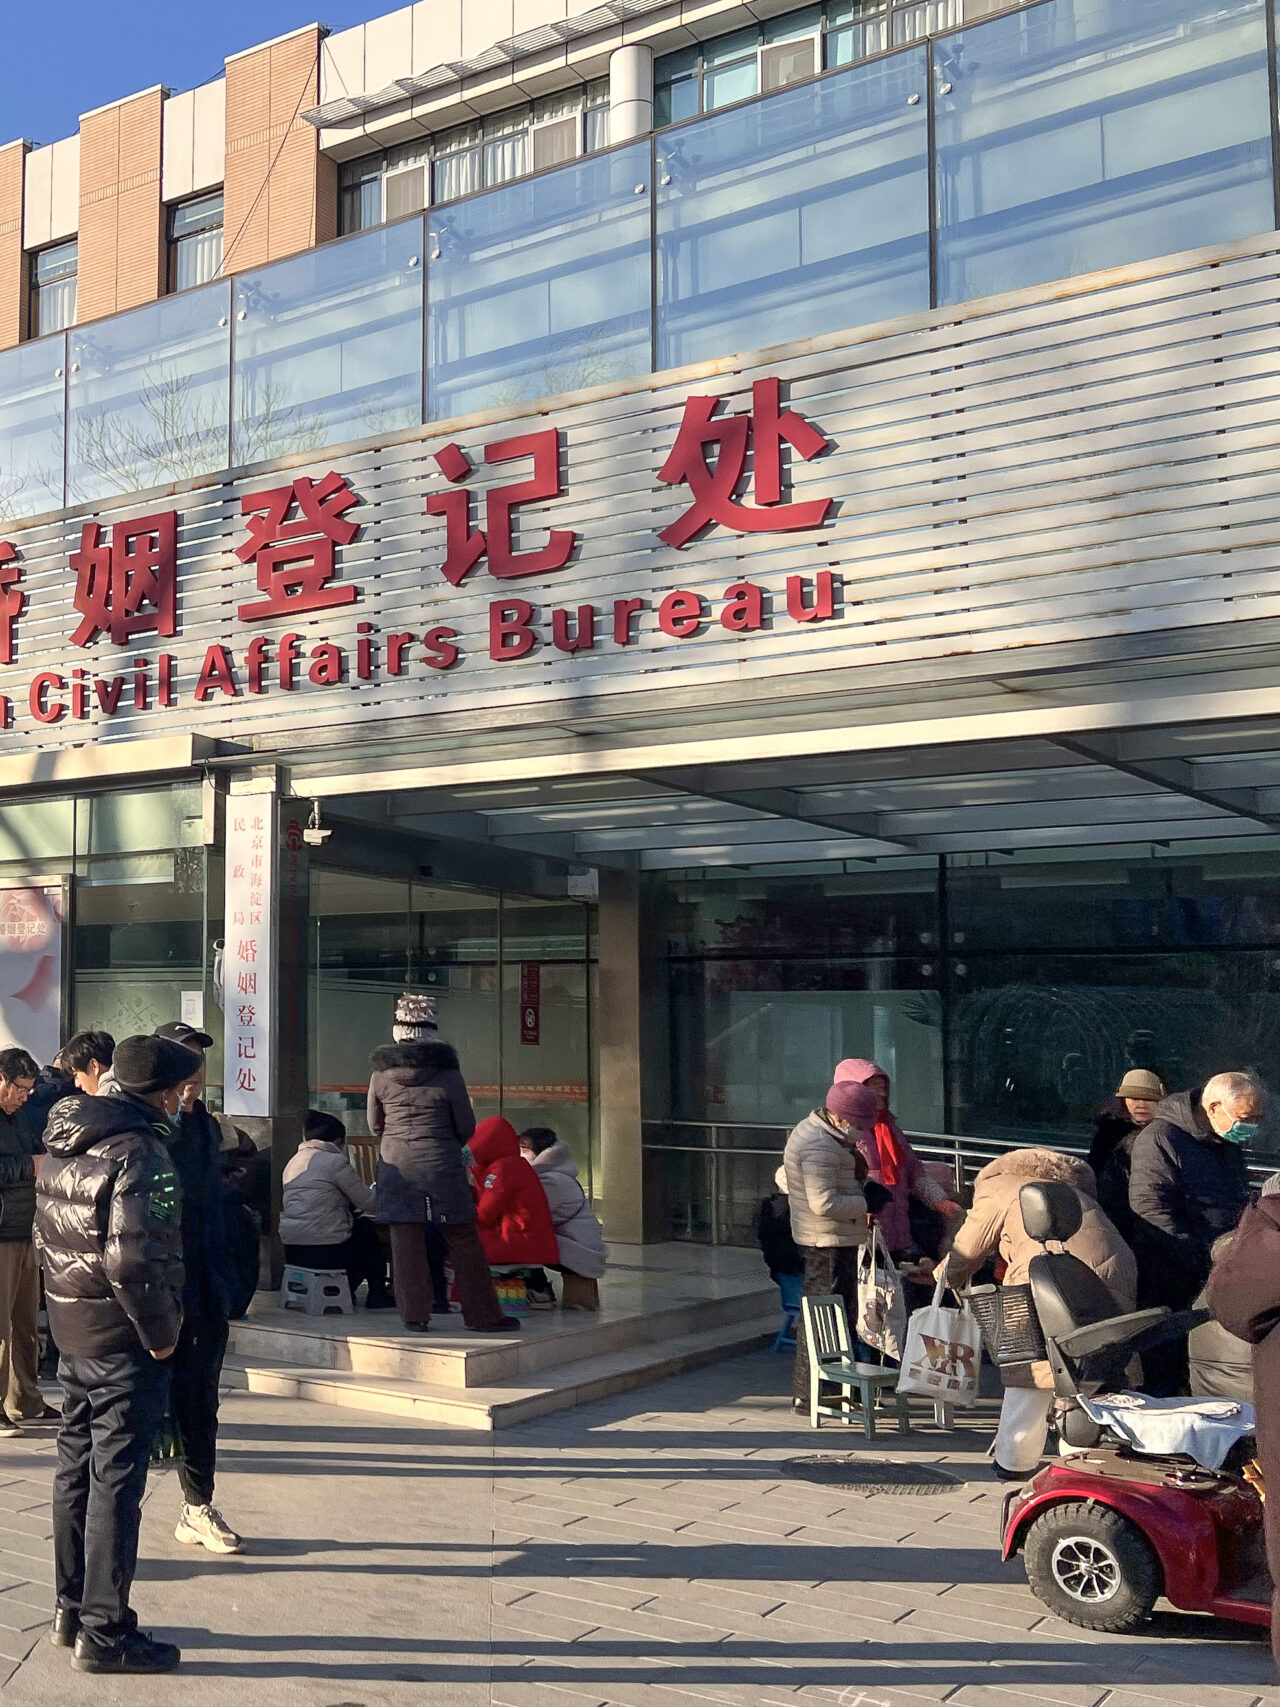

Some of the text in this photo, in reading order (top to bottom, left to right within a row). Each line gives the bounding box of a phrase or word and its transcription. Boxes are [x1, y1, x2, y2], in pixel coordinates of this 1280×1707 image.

[30, 654, 172, 723] Civil
[195, 622, 463, 700] Affairs
[489, 571, 834, 661] Bureau
[250, 816, 264, 926] 北京市海淀区
[236, 939, 258, 1092] 婚姻登记处
